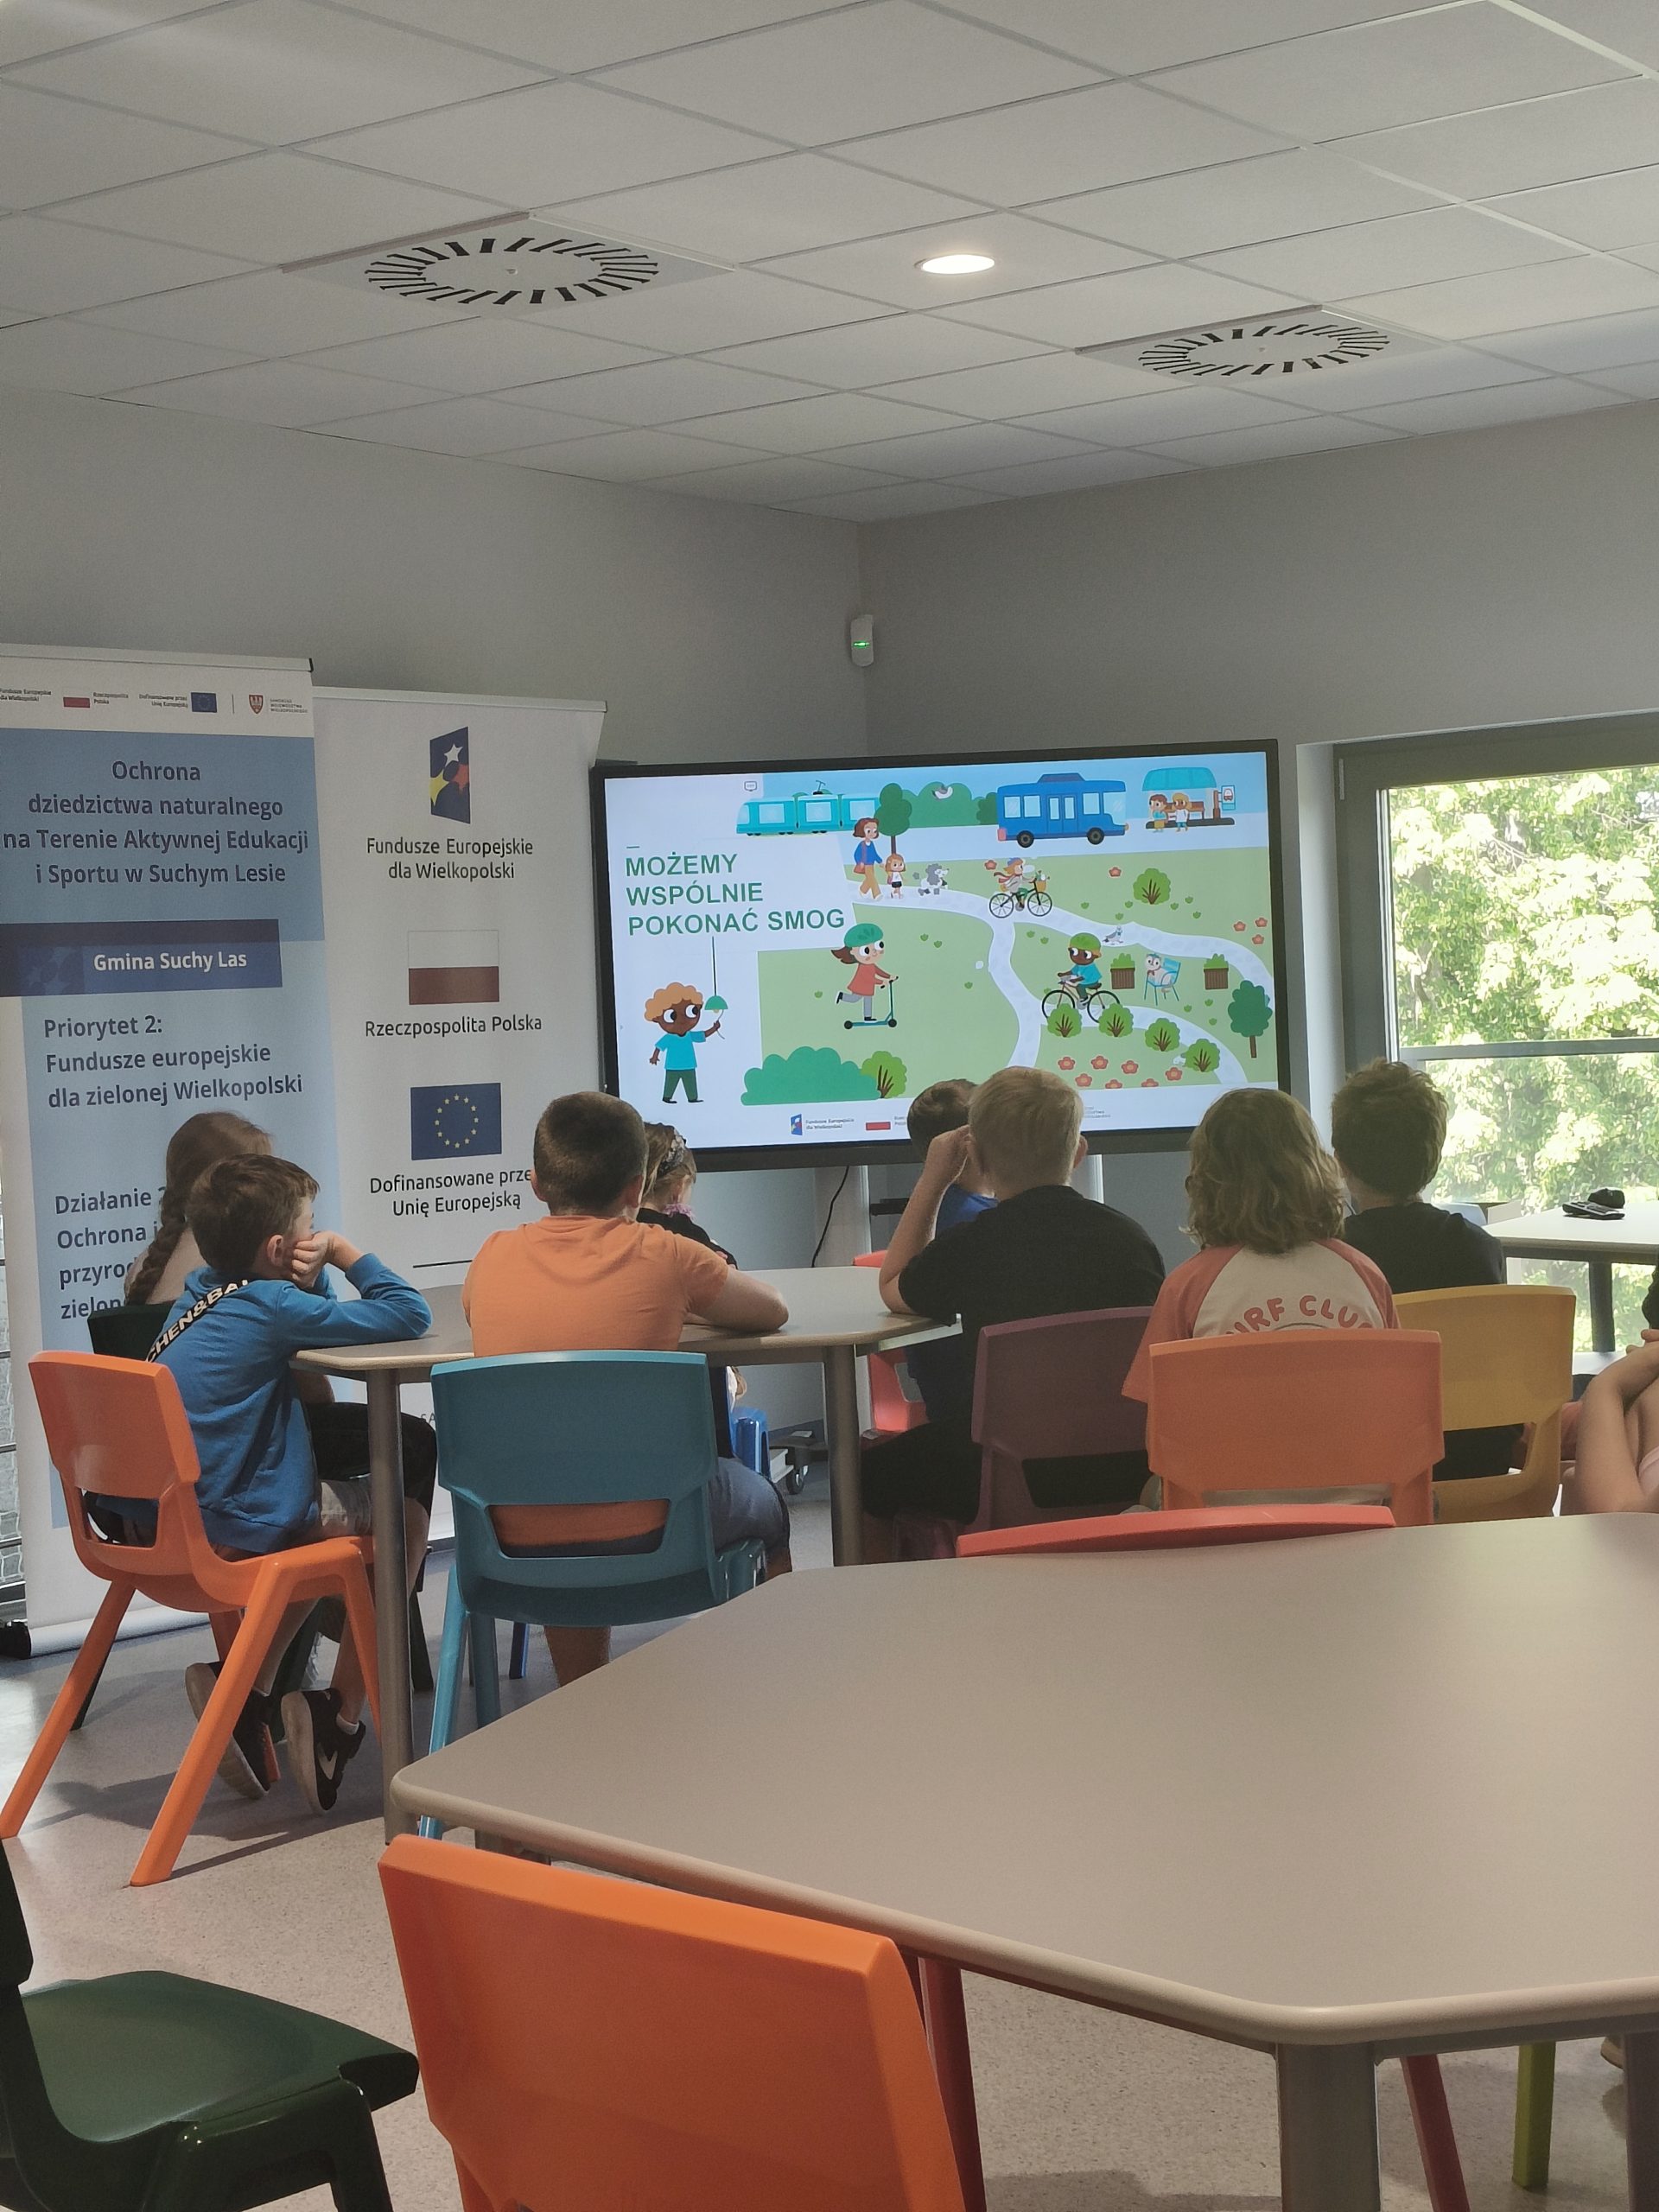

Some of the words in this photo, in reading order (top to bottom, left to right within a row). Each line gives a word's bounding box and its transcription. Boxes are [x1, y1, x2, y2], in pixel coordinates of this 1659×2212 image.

[112, 760, 200, 781] Ochrona
[29, 793, 153, 815] dziedzictwa
[160, 796, 283, 820] naturalnego
[3, 832, 31, 849] na
[36, 830, 118, 849] Terenie
[124, 830, 221, 854] Aktywnej
[227, 830, 309, 854] Edukacji
[367, 836, 440, 855] Fundusze
[447, 838, 533, 858] Europejskie
[36, 865, 41, 884] i
[48, 865, 119, 888] Sportu
[125, 869, 143, 883] w
[149, 864, 229, 887] Suchym
[236, 864, 286, 882] Lesie
[389, 861, 412, 879] dla
[416, 861, 515, 882] Wielkopolski
[626, 851, 738, 877] MOŻEMY
[626, 880, 763, 906] WSPÓLNIE
[628, 907, 759, 936] POKONAĆ
[767, 909, 845, 931] SMOG
[93, 954, 155, 972] Gmina
[160, 952, 213, 972] Suchy
[218, 951, 248, 968] Las
[44, 1015, 138, 1041] Priorytet
[144, 1014, 163, 1034] 2:
[365, 1016, 486, 1039] Rzeczpospolita
[492, 1014, 543, 1032] Polska
[46, 1052, 146, 1073] Fundusze
[152, 1044, 271, 1070] europejskie
[48, 1088, 80, 1108] dla
[86, 1083, 168, 1106] zielonej
[174, 1074, 303, 1101] Wielkopolski
[370, 1172, 494, 1193] Dofinansowane
[55, 1187, 152, 1214] Działanie
[393, 1198, 429, 1217] Unię
[435, 1191, 521, 1213] Europejską
[57, 1226, 146, 1249] Ochrona
[60, 1296, 126, 1319] zielon
